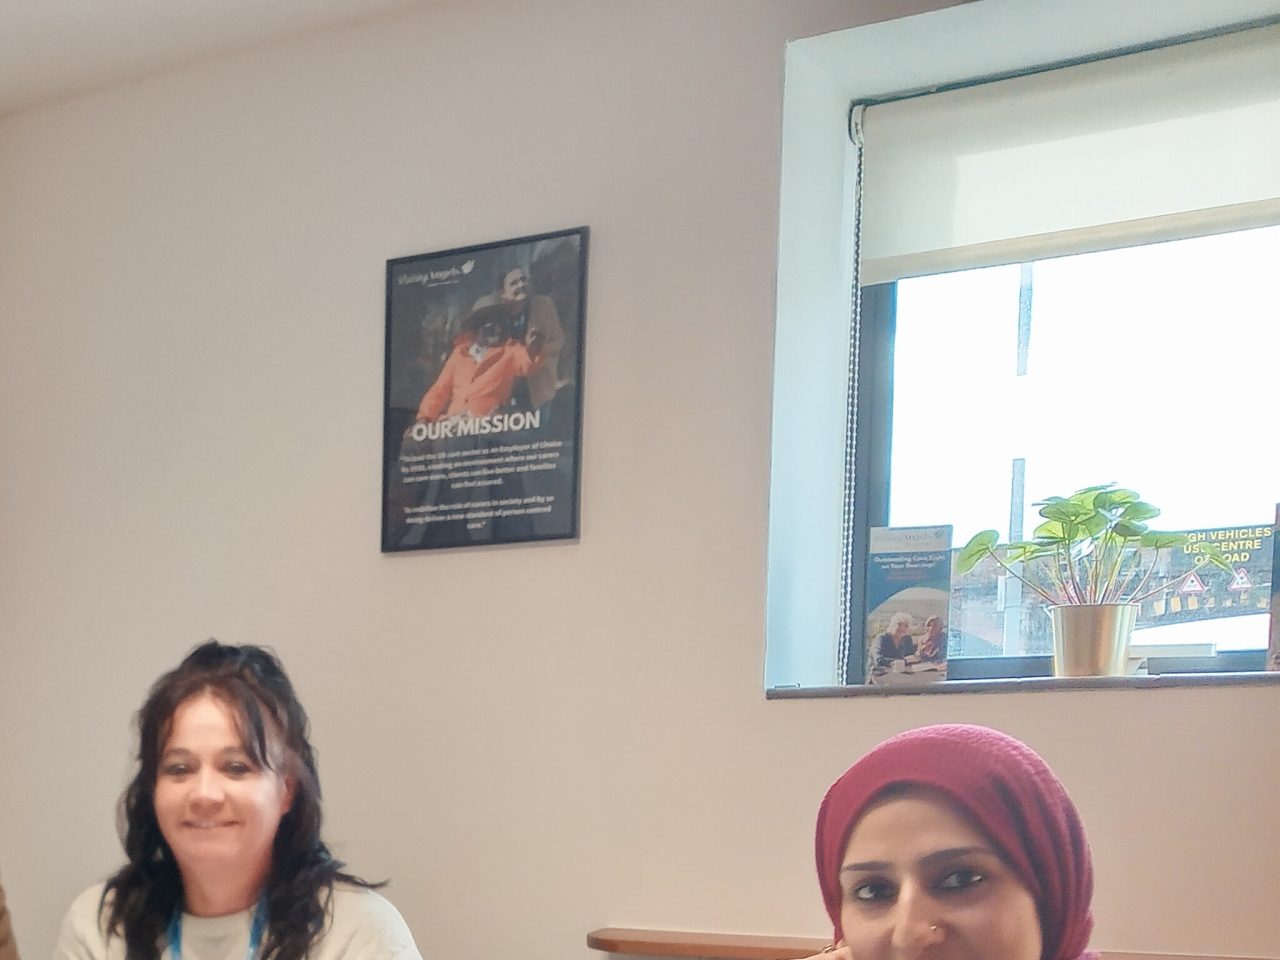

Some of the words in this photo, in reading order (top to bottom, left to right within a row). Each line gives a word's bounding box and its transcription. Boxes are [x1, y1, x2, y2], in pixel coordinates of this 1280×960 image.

[412, 420, 454, 442] OUR
[456, 410, 542, 437] MISSION
[1183, 532, 1207, 542] GH
[1209, 527, 1272, 540] VEHICLES
